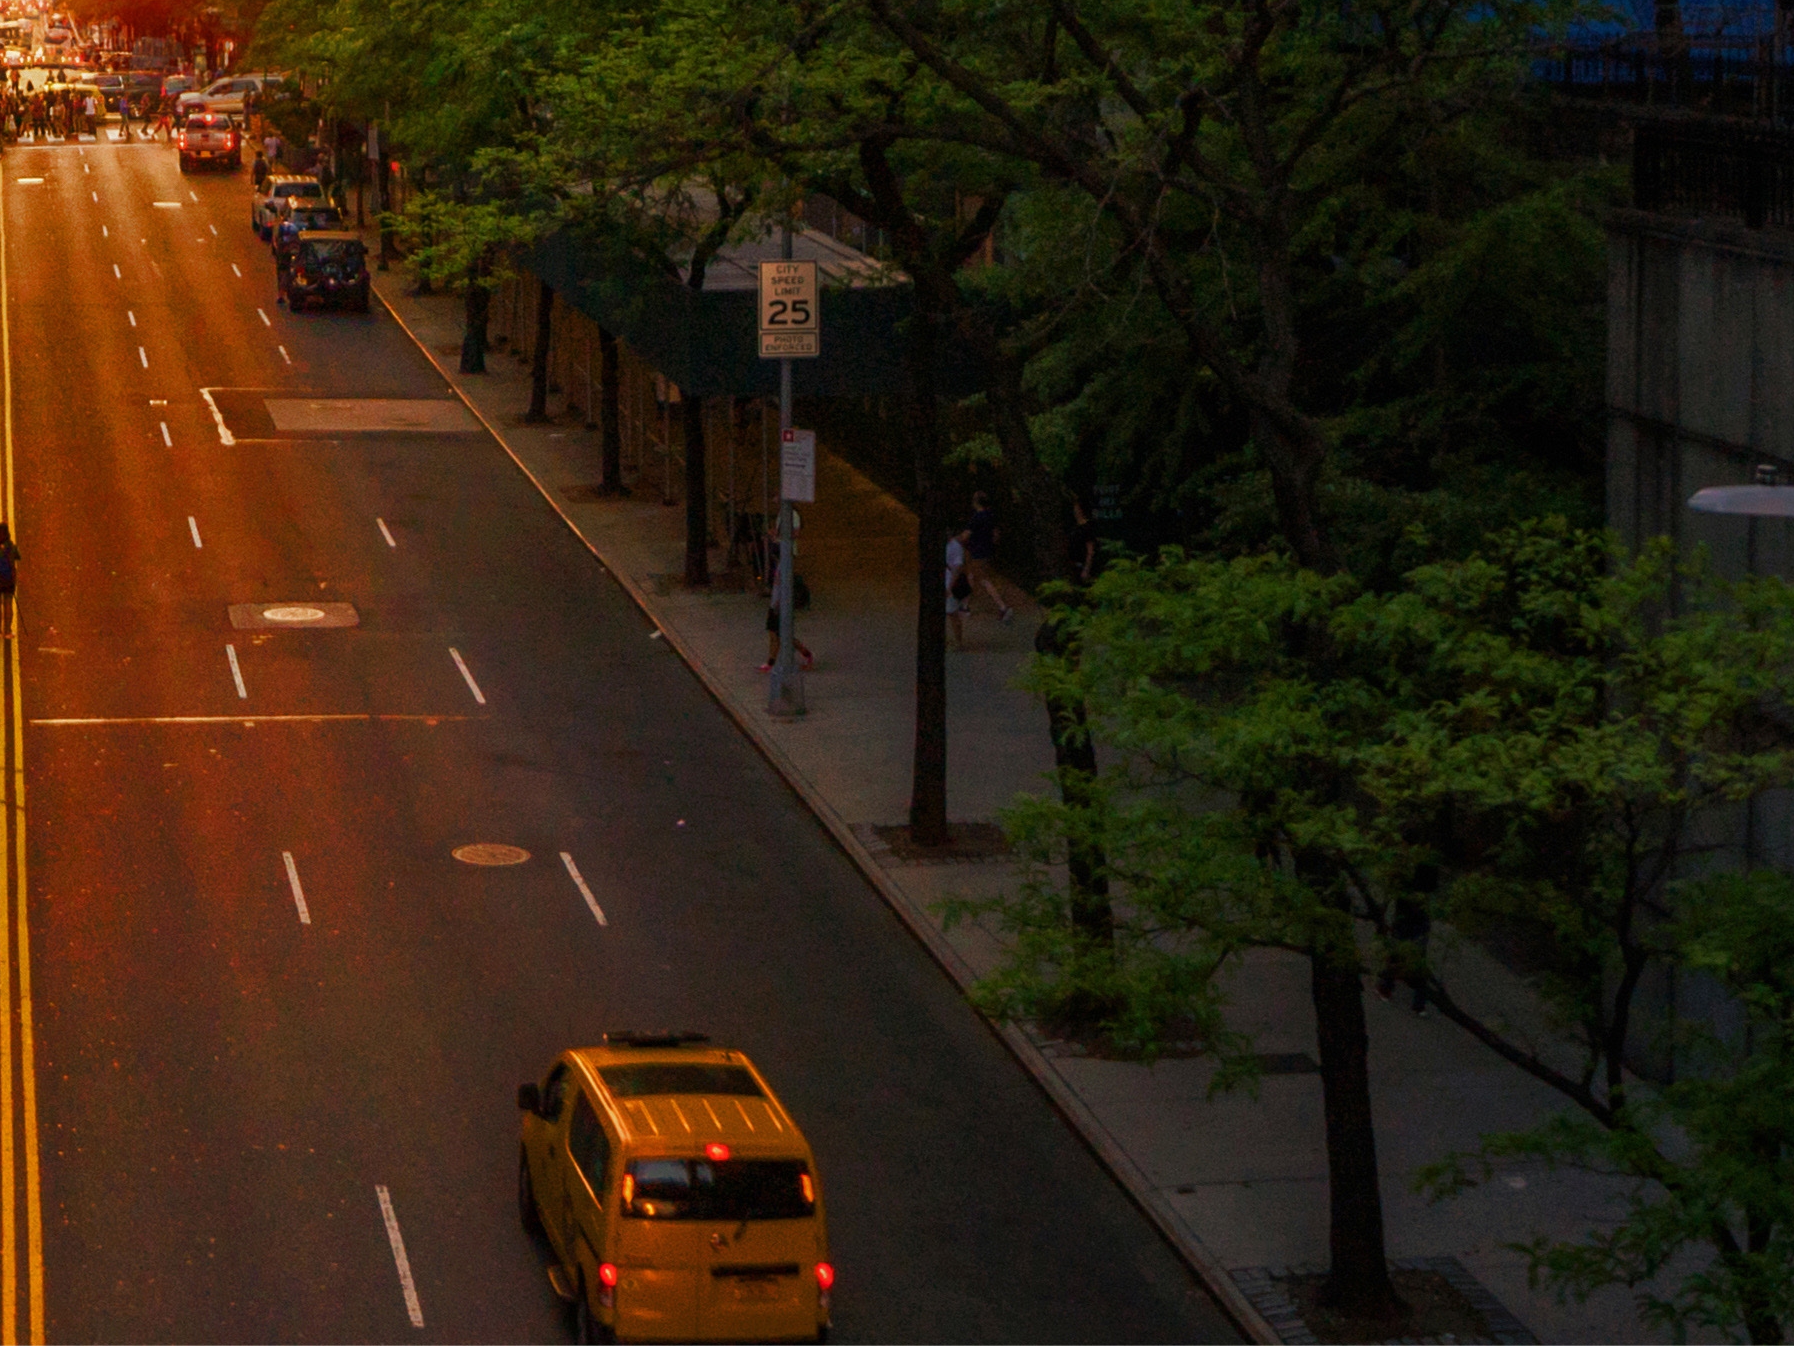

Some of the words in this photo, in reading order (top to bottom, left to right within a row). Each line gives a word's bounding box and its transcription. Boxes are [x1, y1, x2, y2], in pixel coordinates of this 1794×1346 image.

[776, 265, 799, 274] CITY
[771, 276, 804, 285] SPEED
[774, 287, 801, 296] LIMIT
[768, 299, 810, 325] 25
[774, 335, 803, 343] PHOTO
[765, 342, 813, 351] ENFORCED
